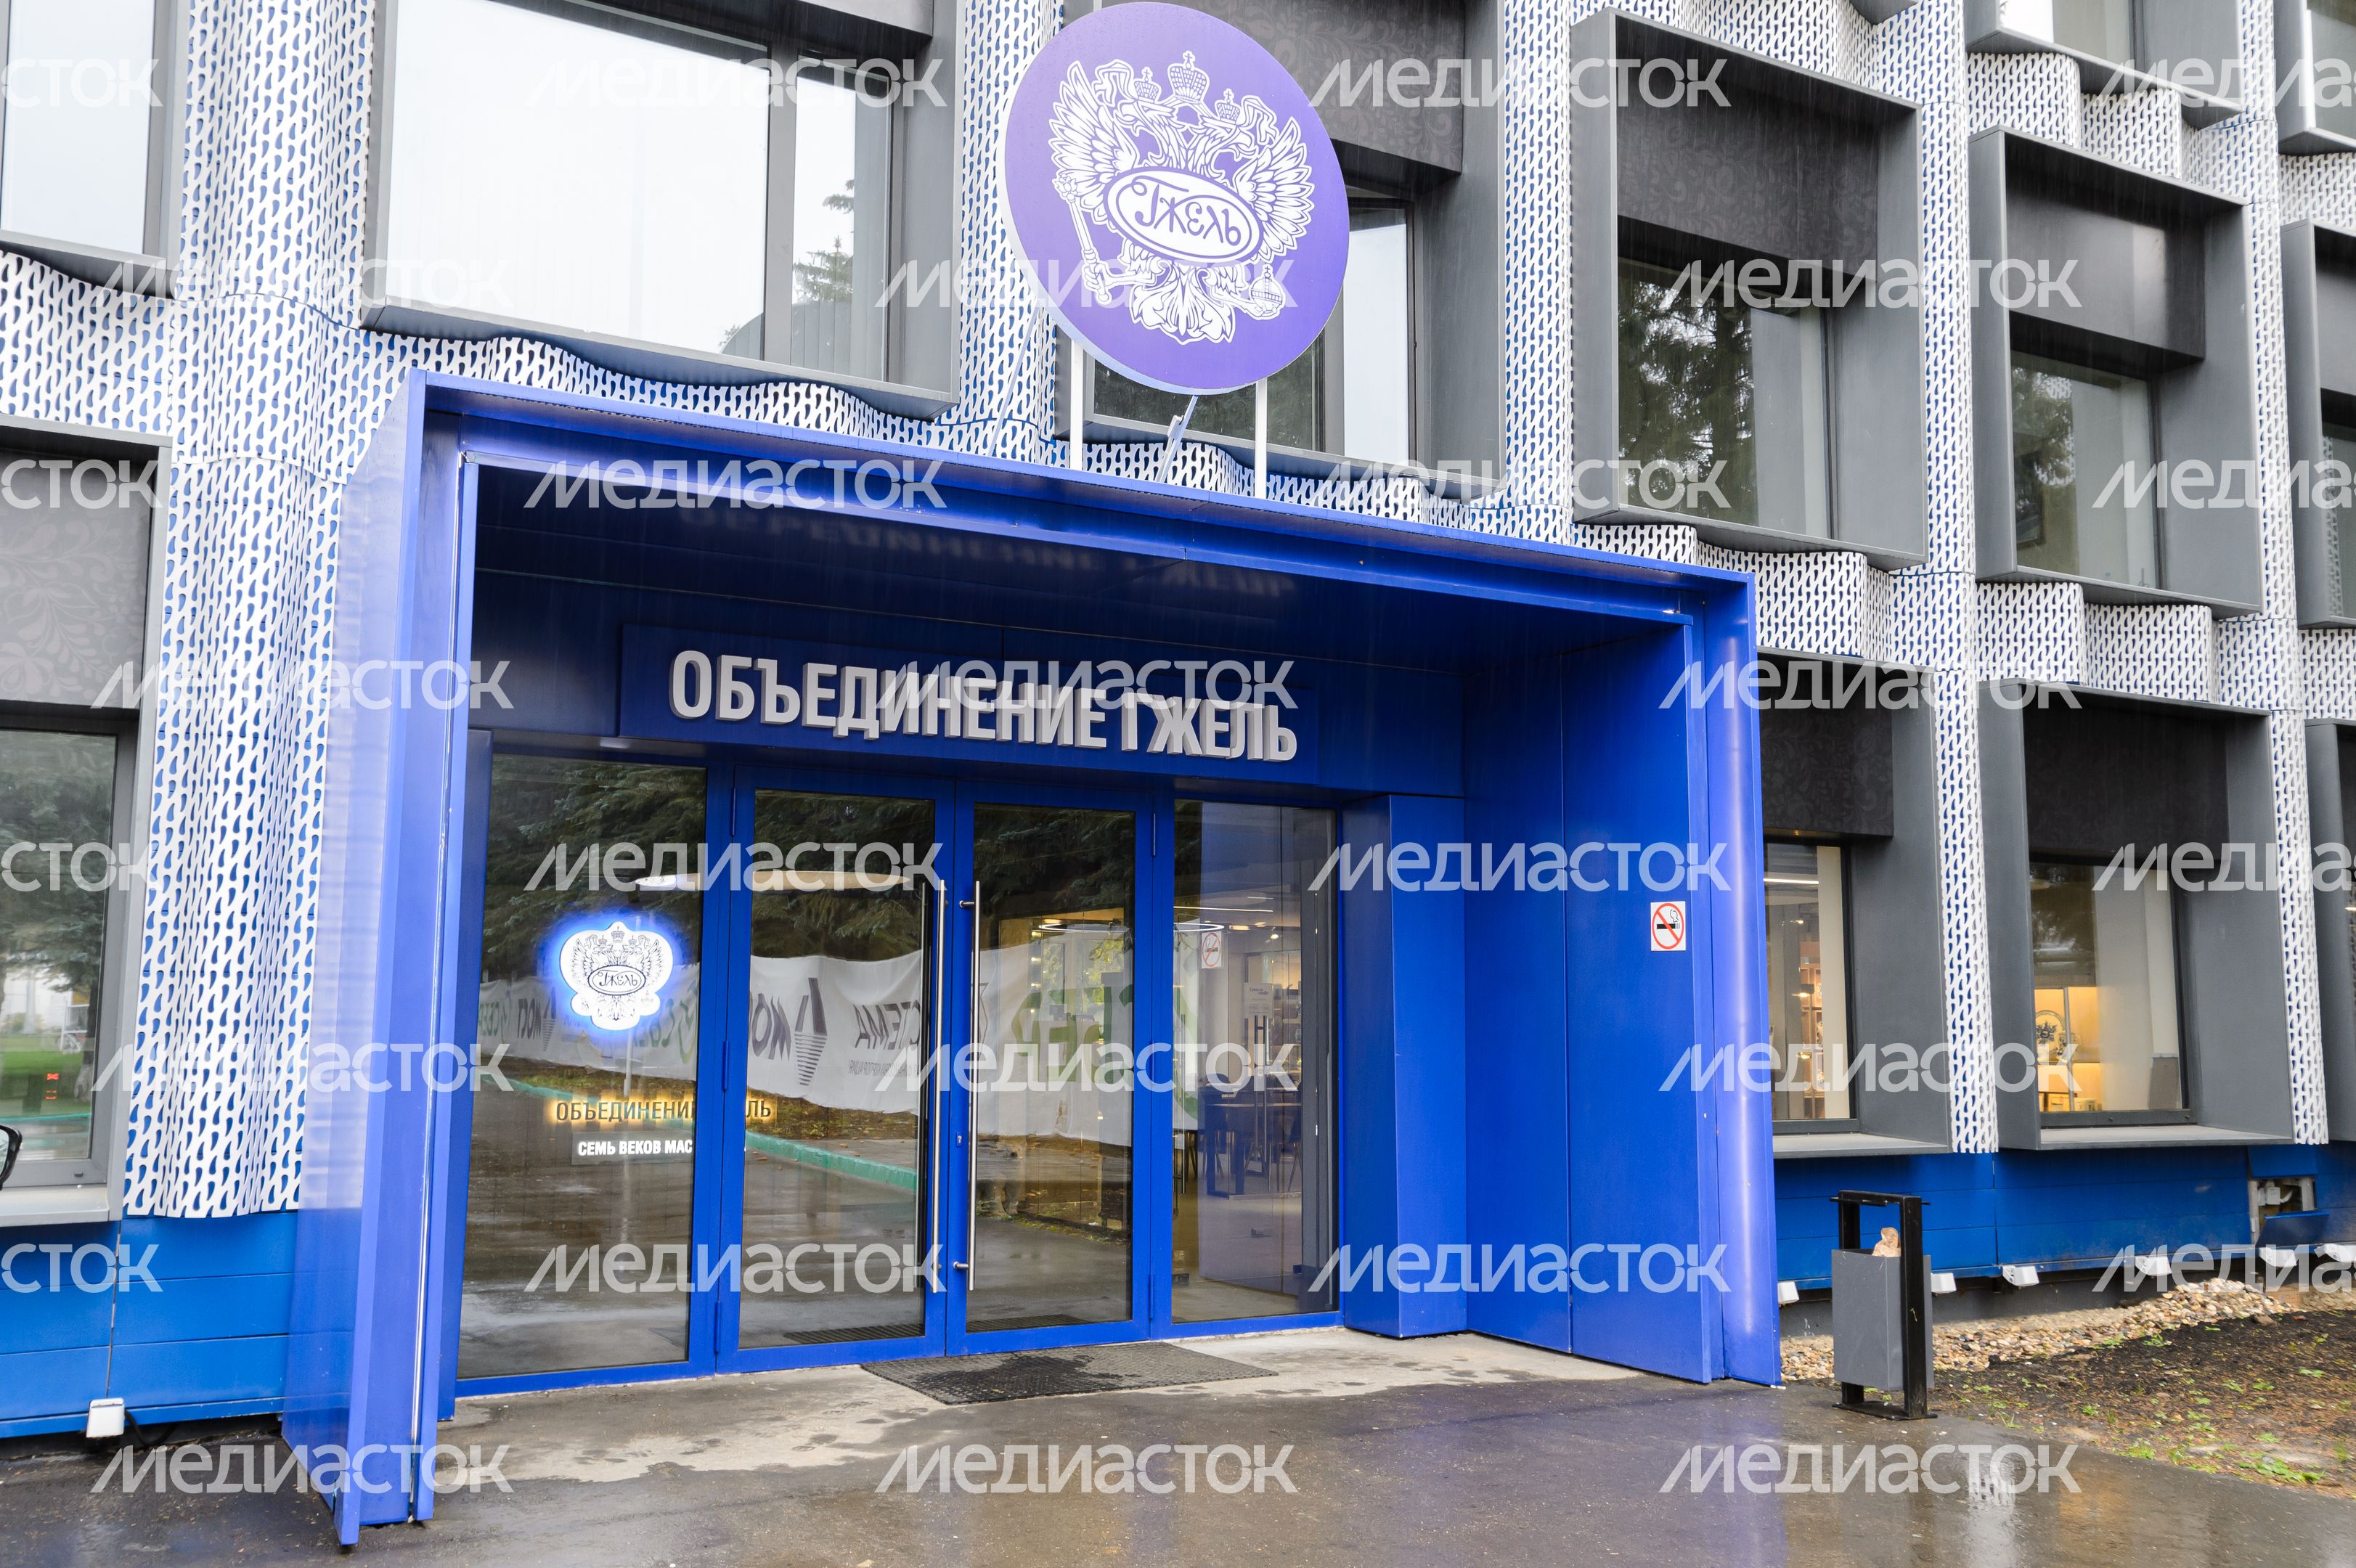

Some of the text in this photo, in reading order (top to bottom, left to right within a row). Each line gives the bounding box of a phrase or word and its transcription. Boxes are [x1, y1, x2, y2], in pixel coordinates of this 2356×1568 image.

[669, 650, 1297, 762] ОБЪЕДИНЕНИЕ ГЖЕЛЬ
[578, 1140, 693, 1156] СЕМЬ ВЕКОВ МАС
